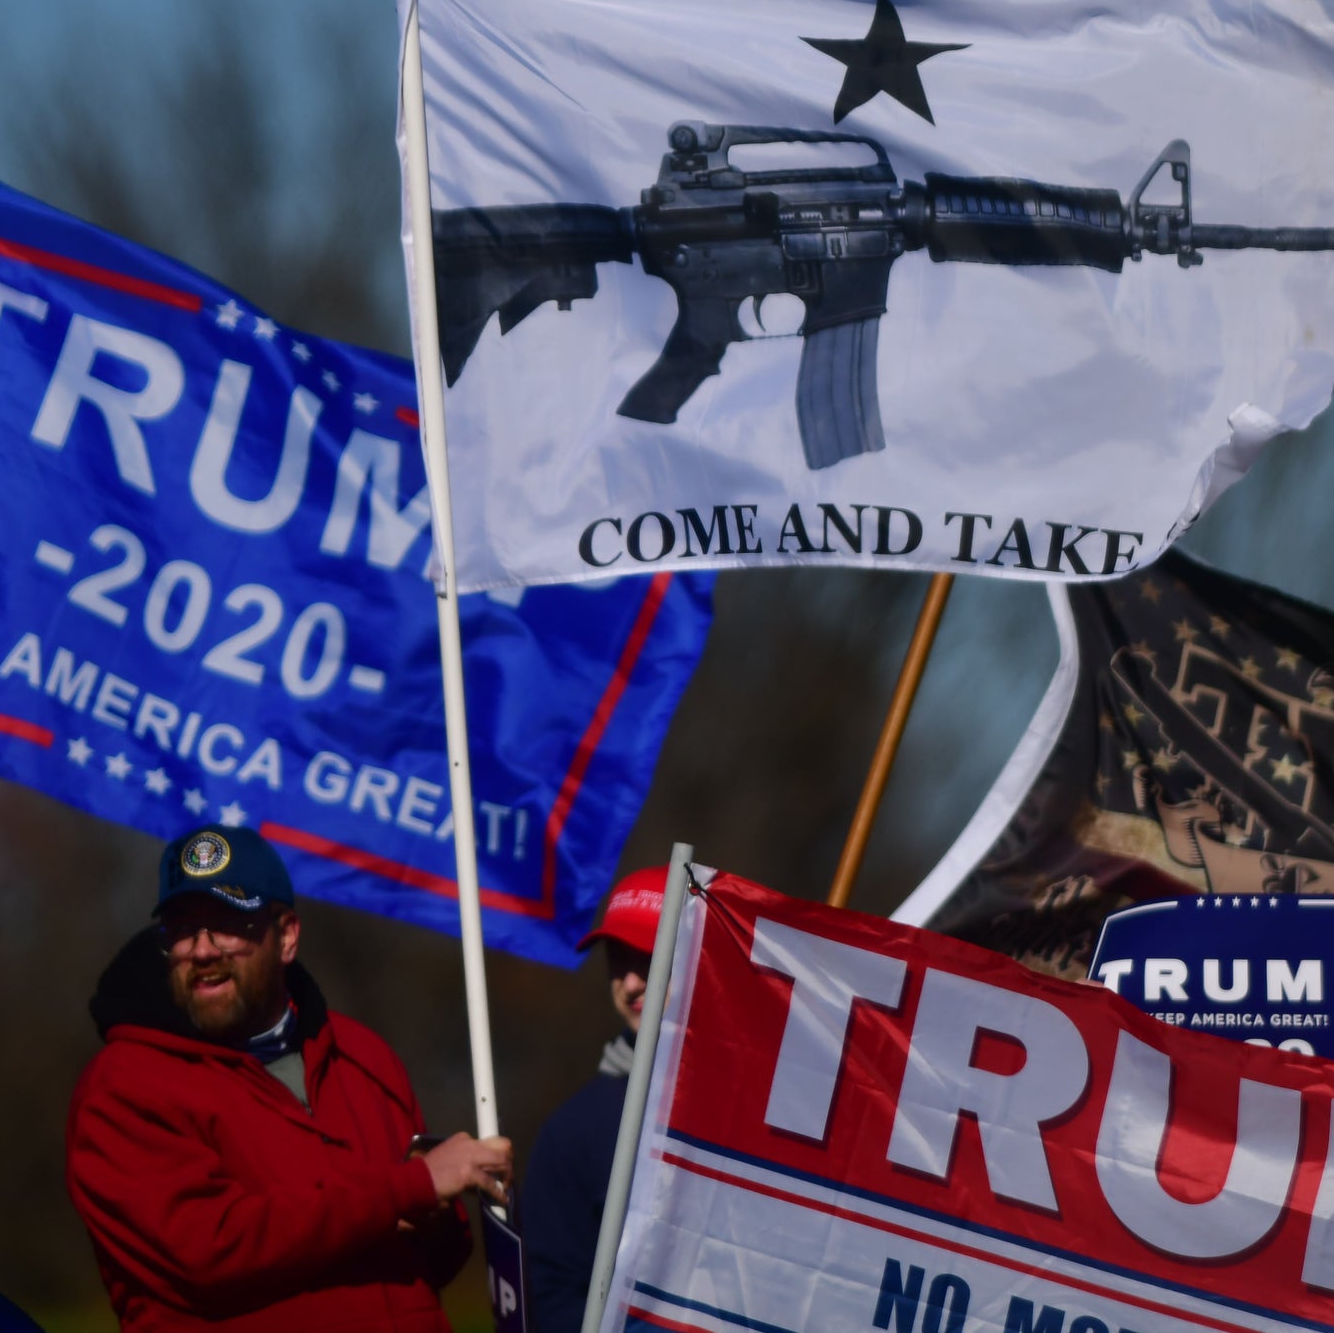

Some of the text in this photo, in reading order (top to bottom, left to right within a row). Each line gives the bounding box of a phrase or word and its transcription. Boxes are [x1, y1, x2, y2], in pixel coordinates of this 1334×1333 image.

[578, 504, 763, 566] COME
[777, 503, 923, 555] AND
[944, 512, 1143, 575] TAKE
[35, 524, 386, 700] -2020-
[1147, 1013, 1328, 1026] EEP AMERICA GREAT!
[872, 1257, 971, 1333] NO
